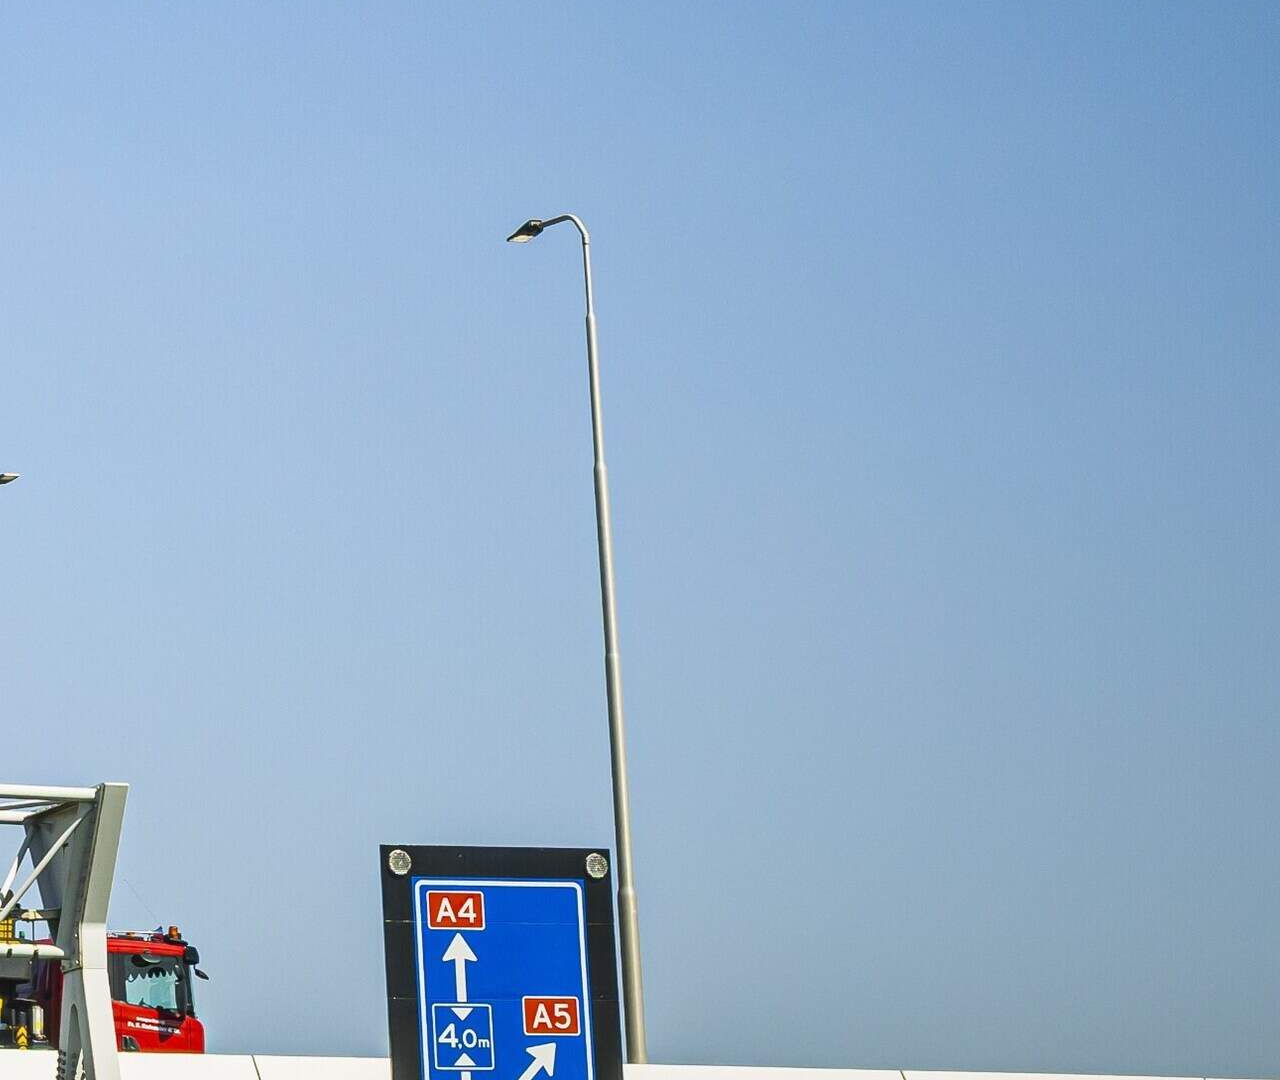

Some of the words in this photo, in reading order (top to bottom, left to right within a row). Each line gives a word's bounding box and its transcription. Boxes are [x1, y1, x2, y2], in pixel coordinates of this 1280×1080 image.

[436, 897, 476, 923] A4
[532, 1003, 571, 1029] A5
[438, 1023, 490, 1049] 4,0m
